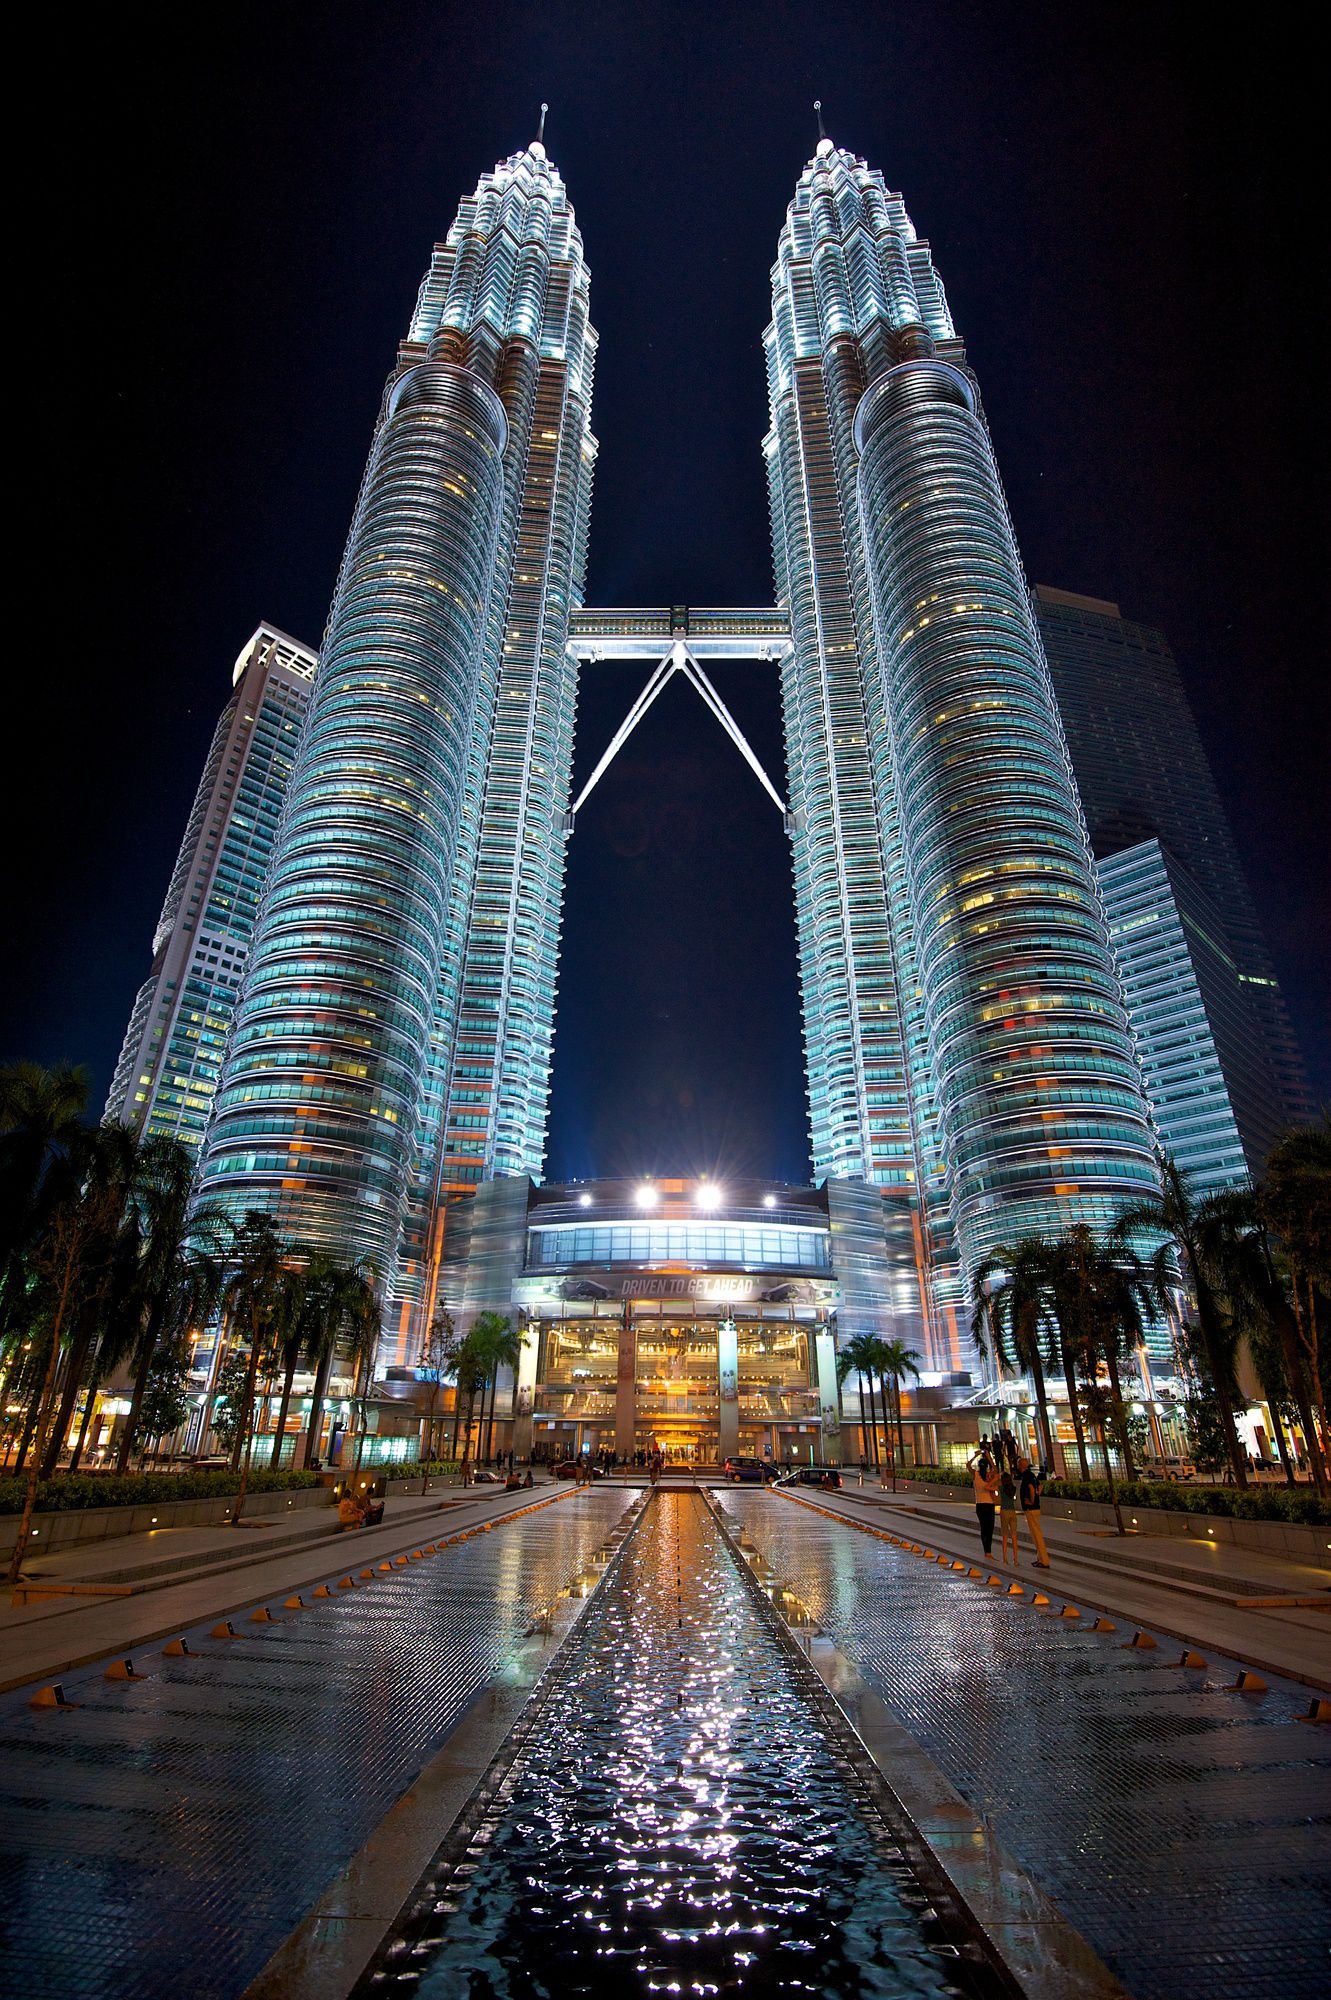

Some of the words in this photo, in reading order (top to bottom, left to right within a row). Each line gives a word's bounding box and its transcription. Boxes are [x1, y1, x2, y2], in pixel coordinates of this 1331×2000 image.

[621, 1279, 667, 1295] DRIVEN
[669, 1279, 685, 1294] TO
[687, 1278, 711, 1295] GET
[713, 1279, 753, 1295] AHEAD
